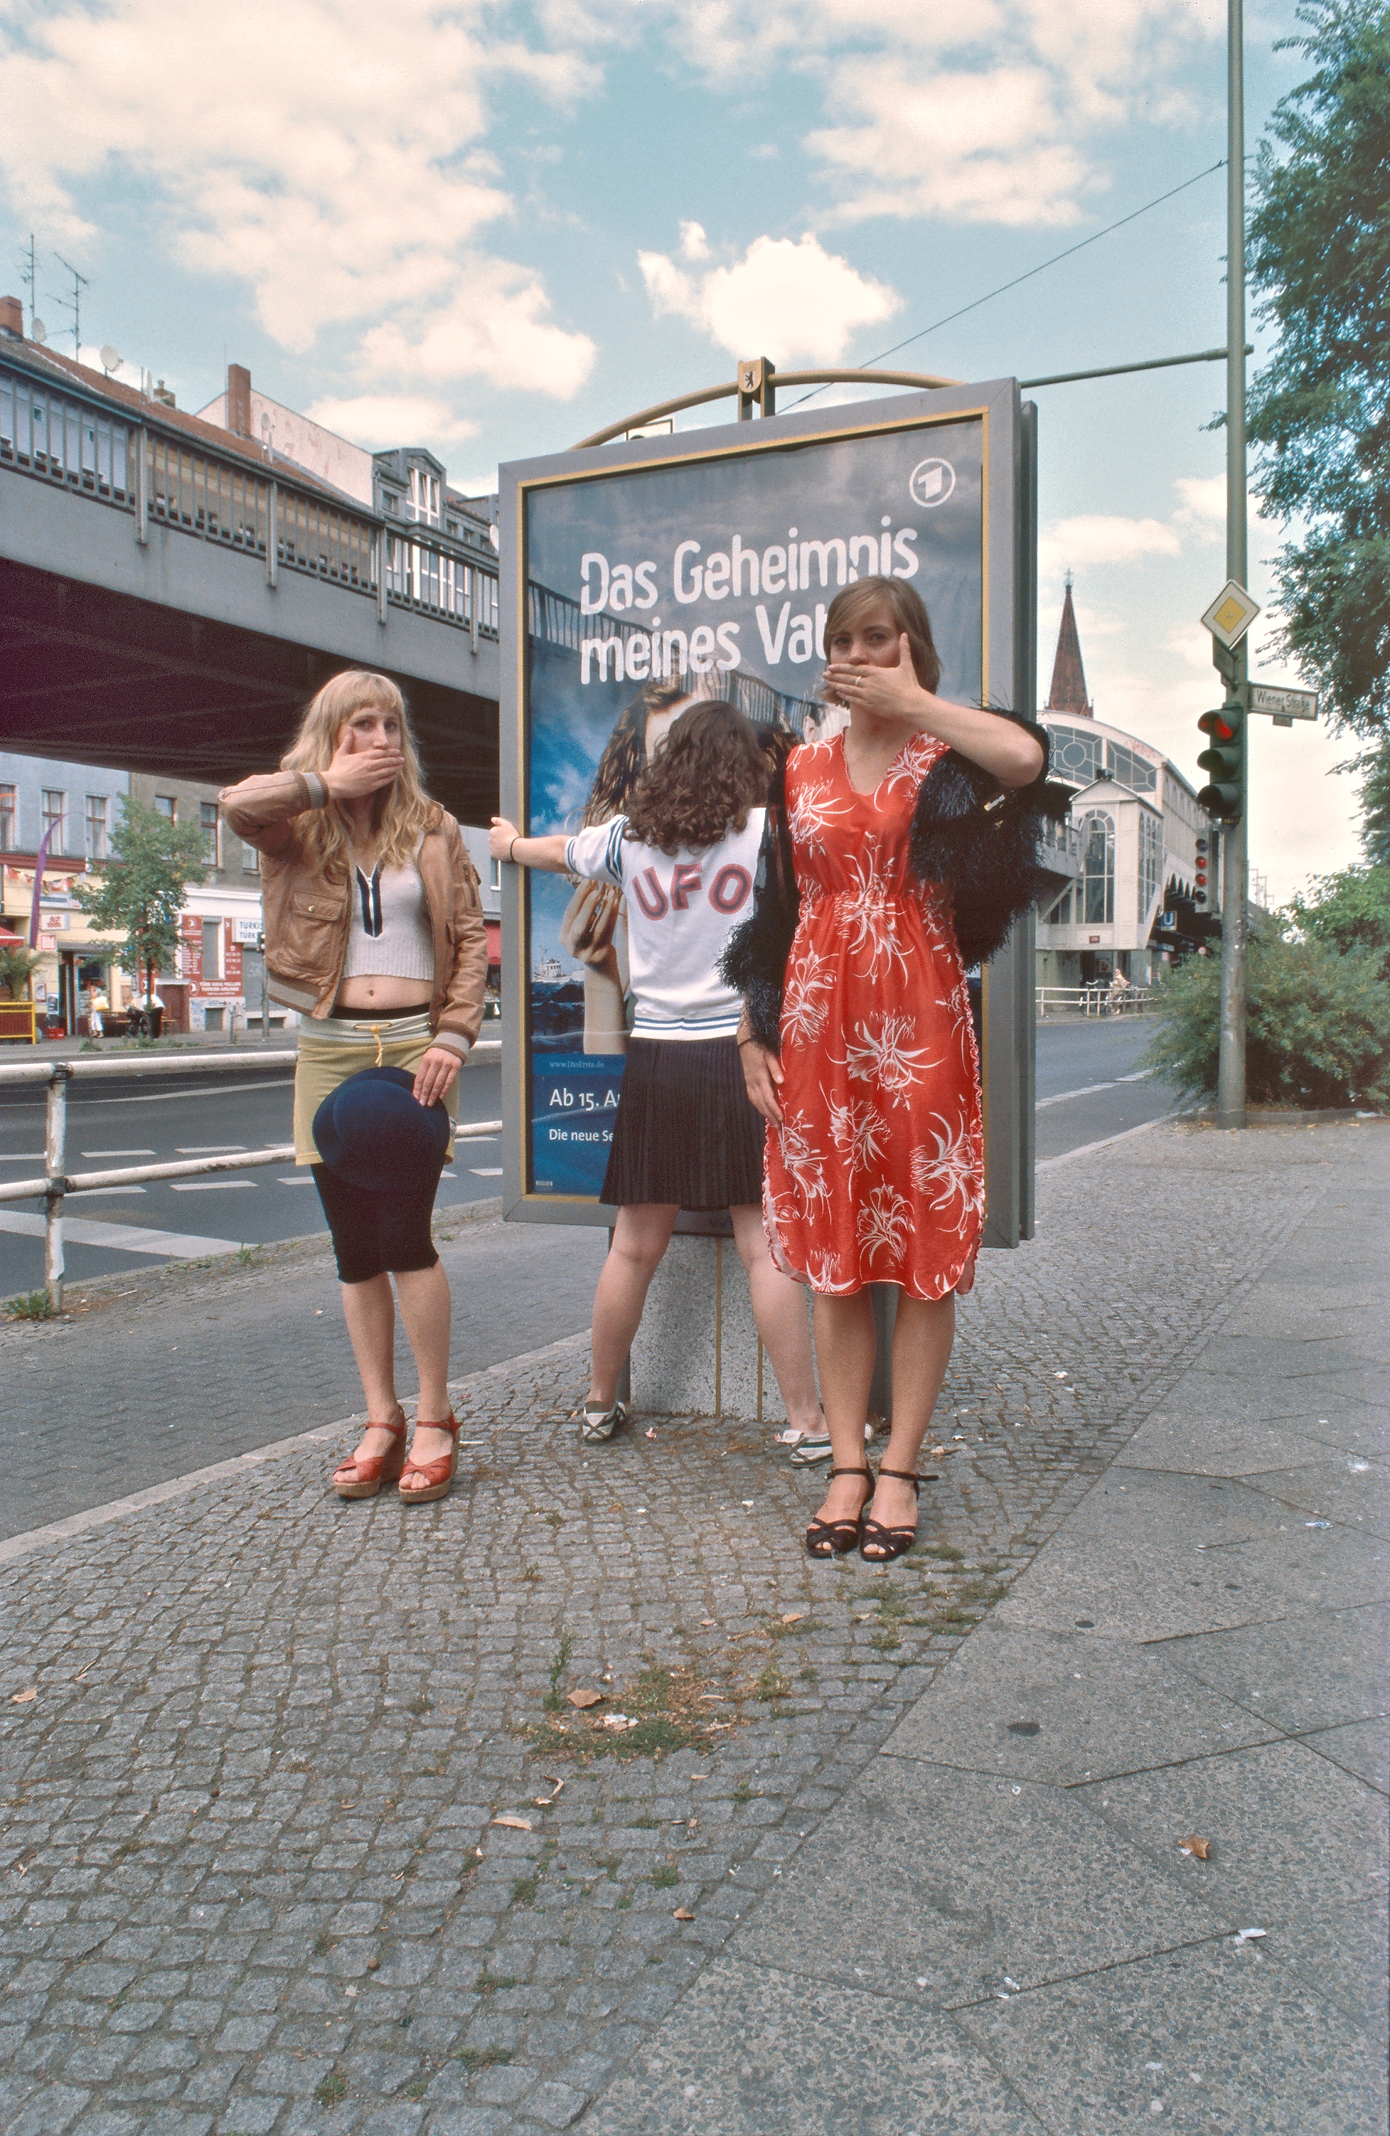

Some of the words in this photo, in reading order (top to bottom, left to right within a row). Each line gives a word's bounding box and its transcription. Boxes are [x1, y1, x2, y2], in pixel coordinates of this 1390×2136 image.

[580, 552, 659, 616] Das
[673, 516, 920, 605] Geheimnis
[580, 615, 742, 685] meines
[1256, 689, 1284, 706] Wiener
[631, 862, 753, 921] UFO
[1164, 912, 1174, 925] U
[549, 1088, 574, 1107] Ab
[578, 1092, 600, 1111] 15.
[548, 1128, 568, 1141] Die
[571, 1131, 600, 1142] neue
